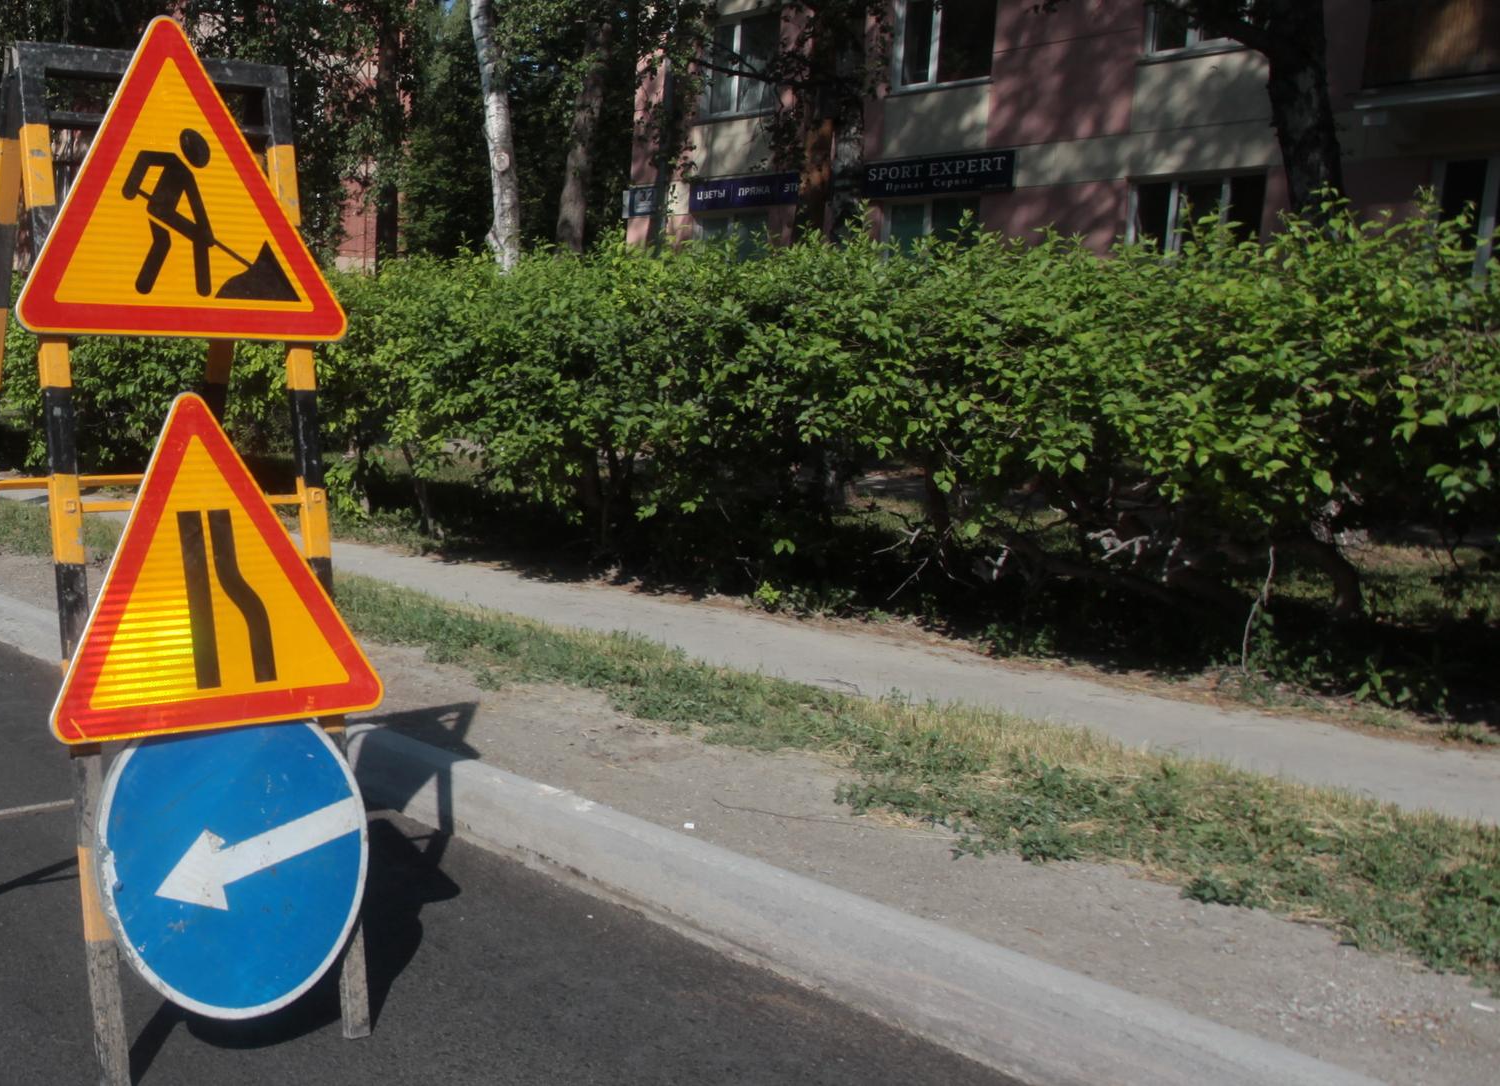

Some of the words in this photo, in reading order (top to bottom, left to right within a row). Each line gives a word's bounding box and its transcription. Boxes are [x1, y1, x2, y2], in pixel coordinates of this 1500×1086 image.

[868, 164, 923, 181] SPORT
[929, 156, 1006, 177] EXPERT
[696, 189, 726, 201] ЦВЕТЫ
[738, 185, 771, 197] ПРЯЖА
